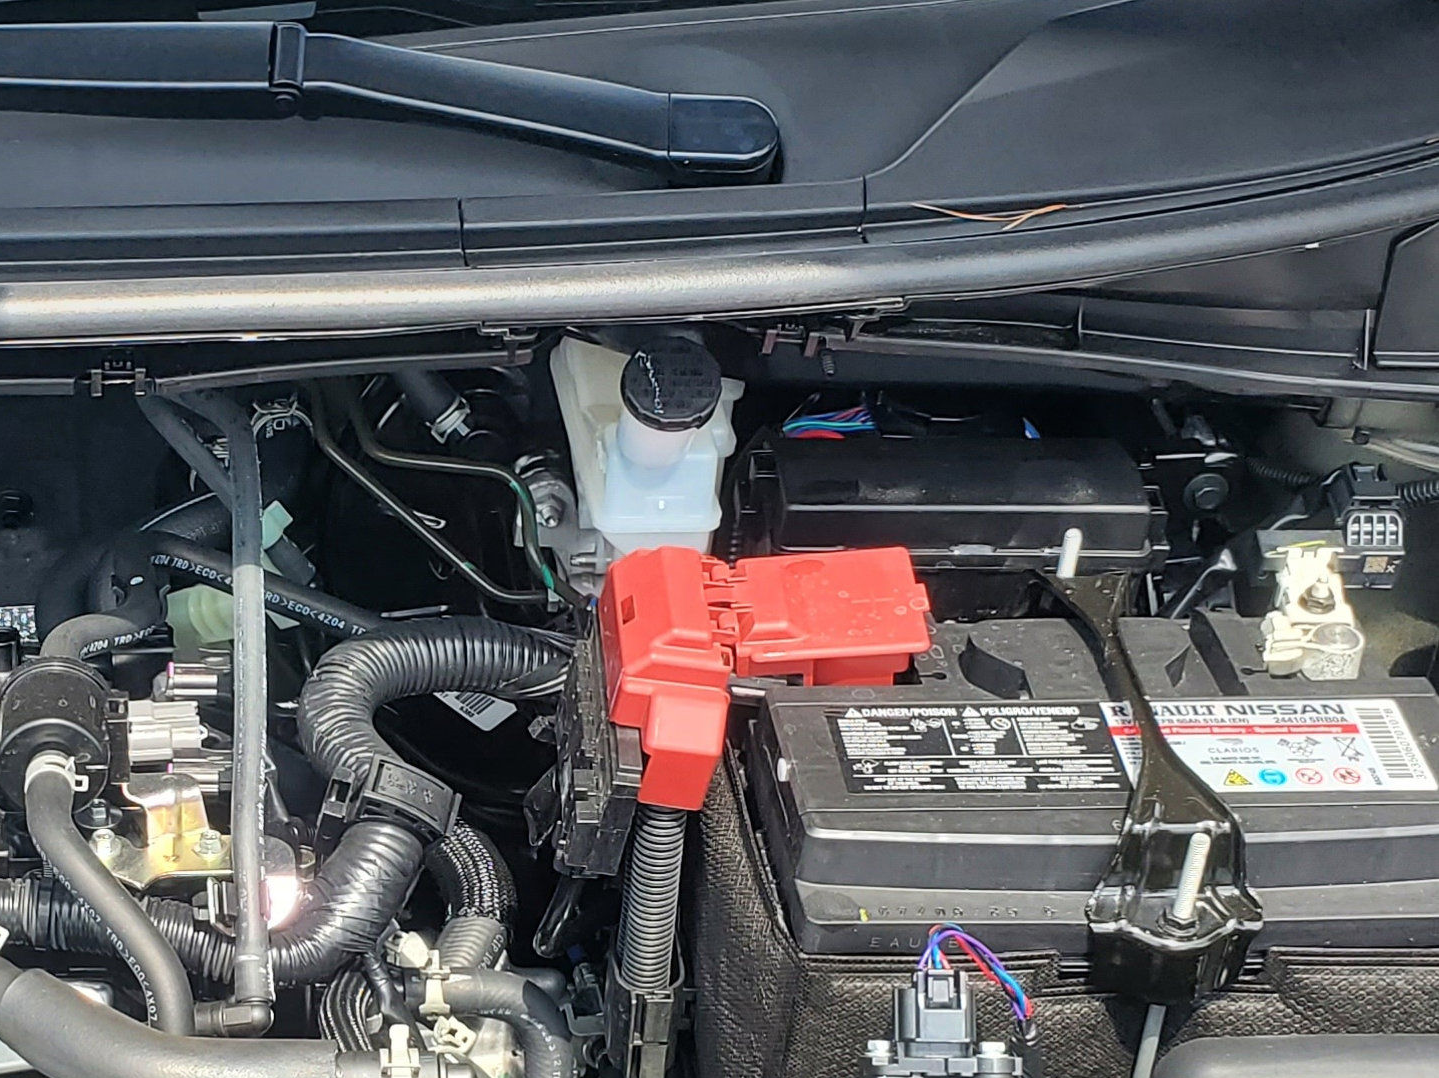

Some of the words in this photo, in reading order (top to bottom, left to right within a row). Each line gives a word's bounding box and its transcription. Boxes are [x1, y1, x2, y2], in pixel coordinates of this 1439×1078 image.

[861, 707, 958, 717] DANGER/POISON
[979, 706, 1080, 716] PELIGRO/VENENO
[1223, 704, 1345, 715] NISSAN
[1207, 746, 1261, 754] CLARIOS
